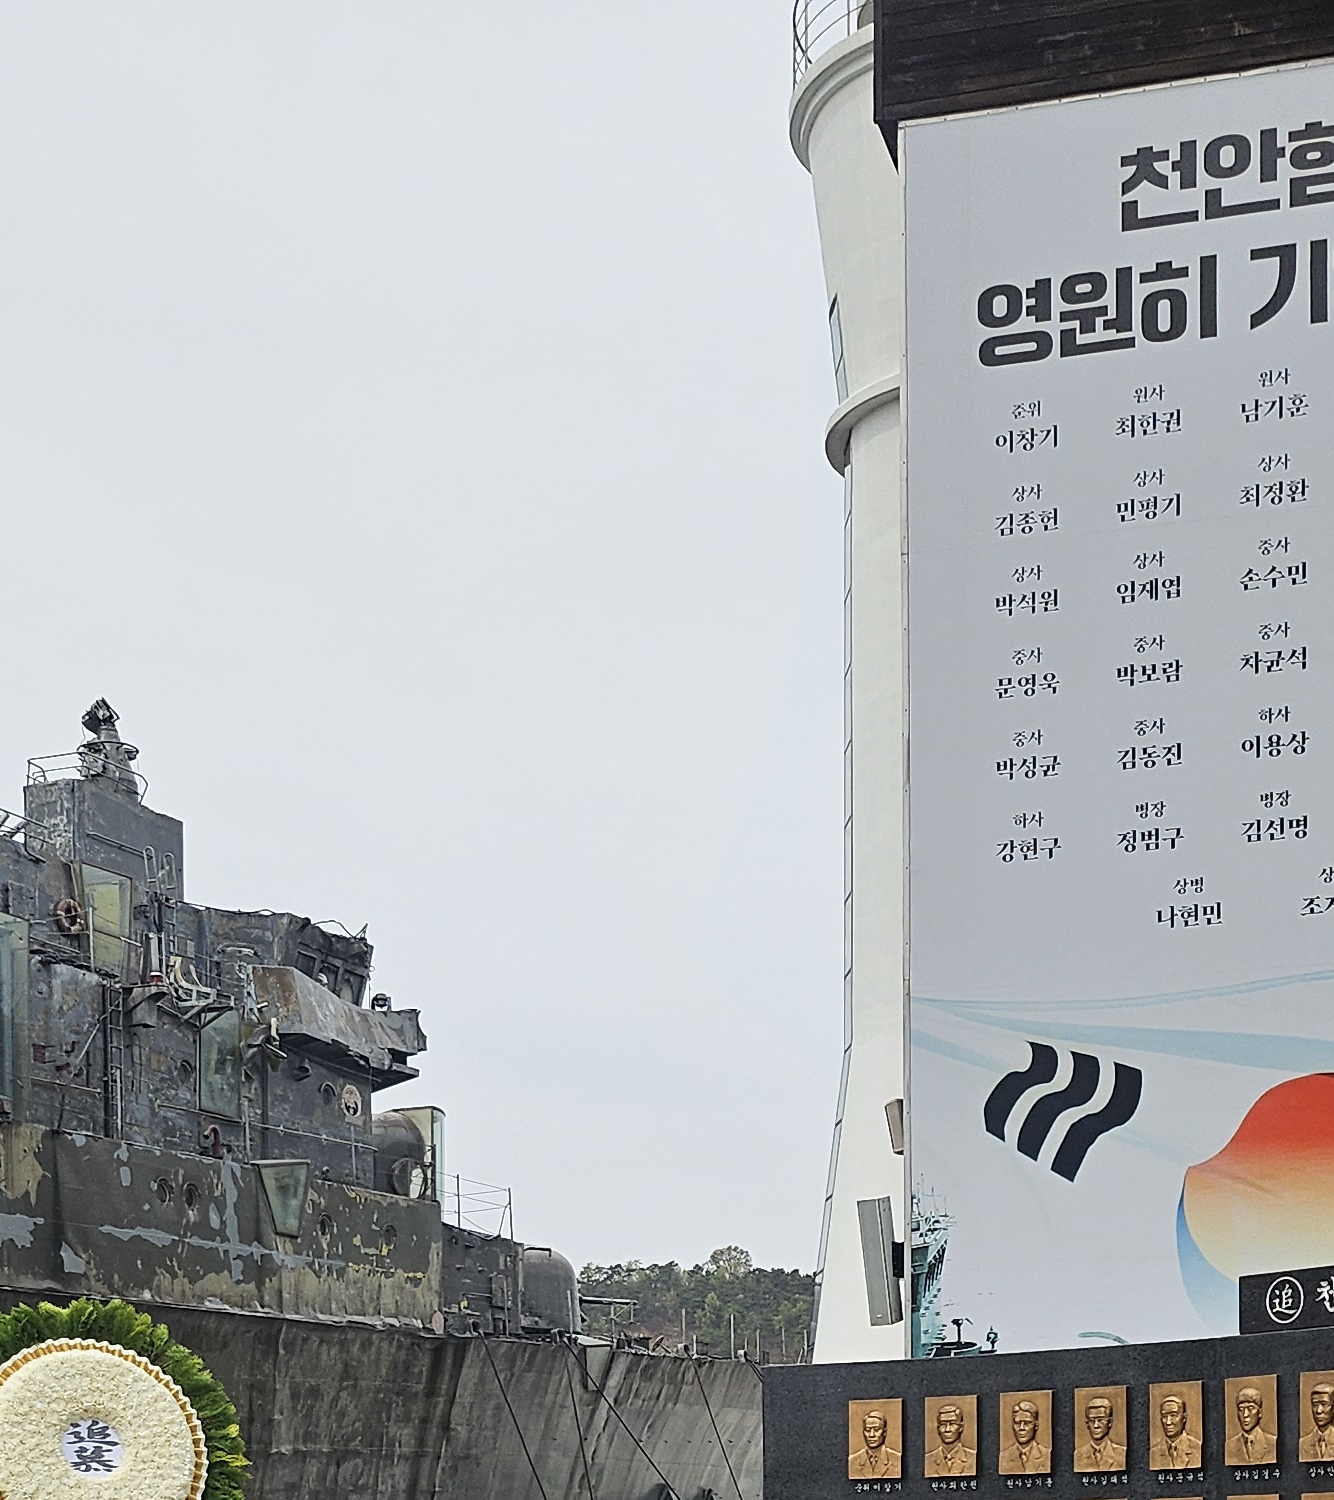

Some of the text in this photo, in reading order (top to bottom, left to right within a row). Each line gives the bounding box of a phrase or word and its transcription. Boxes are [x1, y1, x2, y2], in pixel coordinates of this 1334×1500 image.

[977, 253, 1218, 367] 영원히
[1258, 367, 1291, 388] 원사
[1132, 383, 1166, 404] 원사
[1011, 400, 1041, 420] 준위
[1240, 393, 1310, 424] 남기훈
[1114, 408, 1182, 439] 최한권
[995, 424, 1058, 454] 이창기
[1257, 453, 1291, 473] 상사
[1132, 468, 1166, 488] 상사
[1011, 483, 1043, 503] 상사
[1238, 477, 1310, 508] 최정환
[1115, 492, 1181, 523] 민평기
[994, 507, 1059, 537] 김종헌
[1257, 536, 1291, 556] 중사
[1132, 550, 1166, 570] 상사
[1011, 564, 1044, 584] 상사
[1239, 561, 1308, 592] 손수민
[994, 588, 1060, 617] 박석원
[1116, 575, 1181, 605] 임재엽
[1133, 634, 1166, 654] 중사
[1257, 621, 1291, 641] 중사
[1011, 646, 1044, 666] 중사
[1239, 645, 1307, 675] 차균석
[994, 672, 1061, 700] 문영욱
[1116, 658, 1184, 688] 박보람
[1133, 717, 1166, 737] 중사
[1257, 705, 1292, 725] 하사
[1012, 728, 1044, 748] 중사
[1240, 730, 1311, 759] 이용상
[995, 754, 1062, 781] 박성균
[1116, 742, 1183, 771] 김동진
[1135, 800, 1167, 820] 병장
[1259, 789, 1292, 809] 병장
[1012, 811, 1045, 829] 하사
[1240, 814, 1308, 843] 김선명
[995, 837, 1062, 864] 강현구
[1116, 827, 1185, 854] 정범구
[1172, 876, 1204, 895] 상병
[1155, 901, 1223, 929] 나현민
